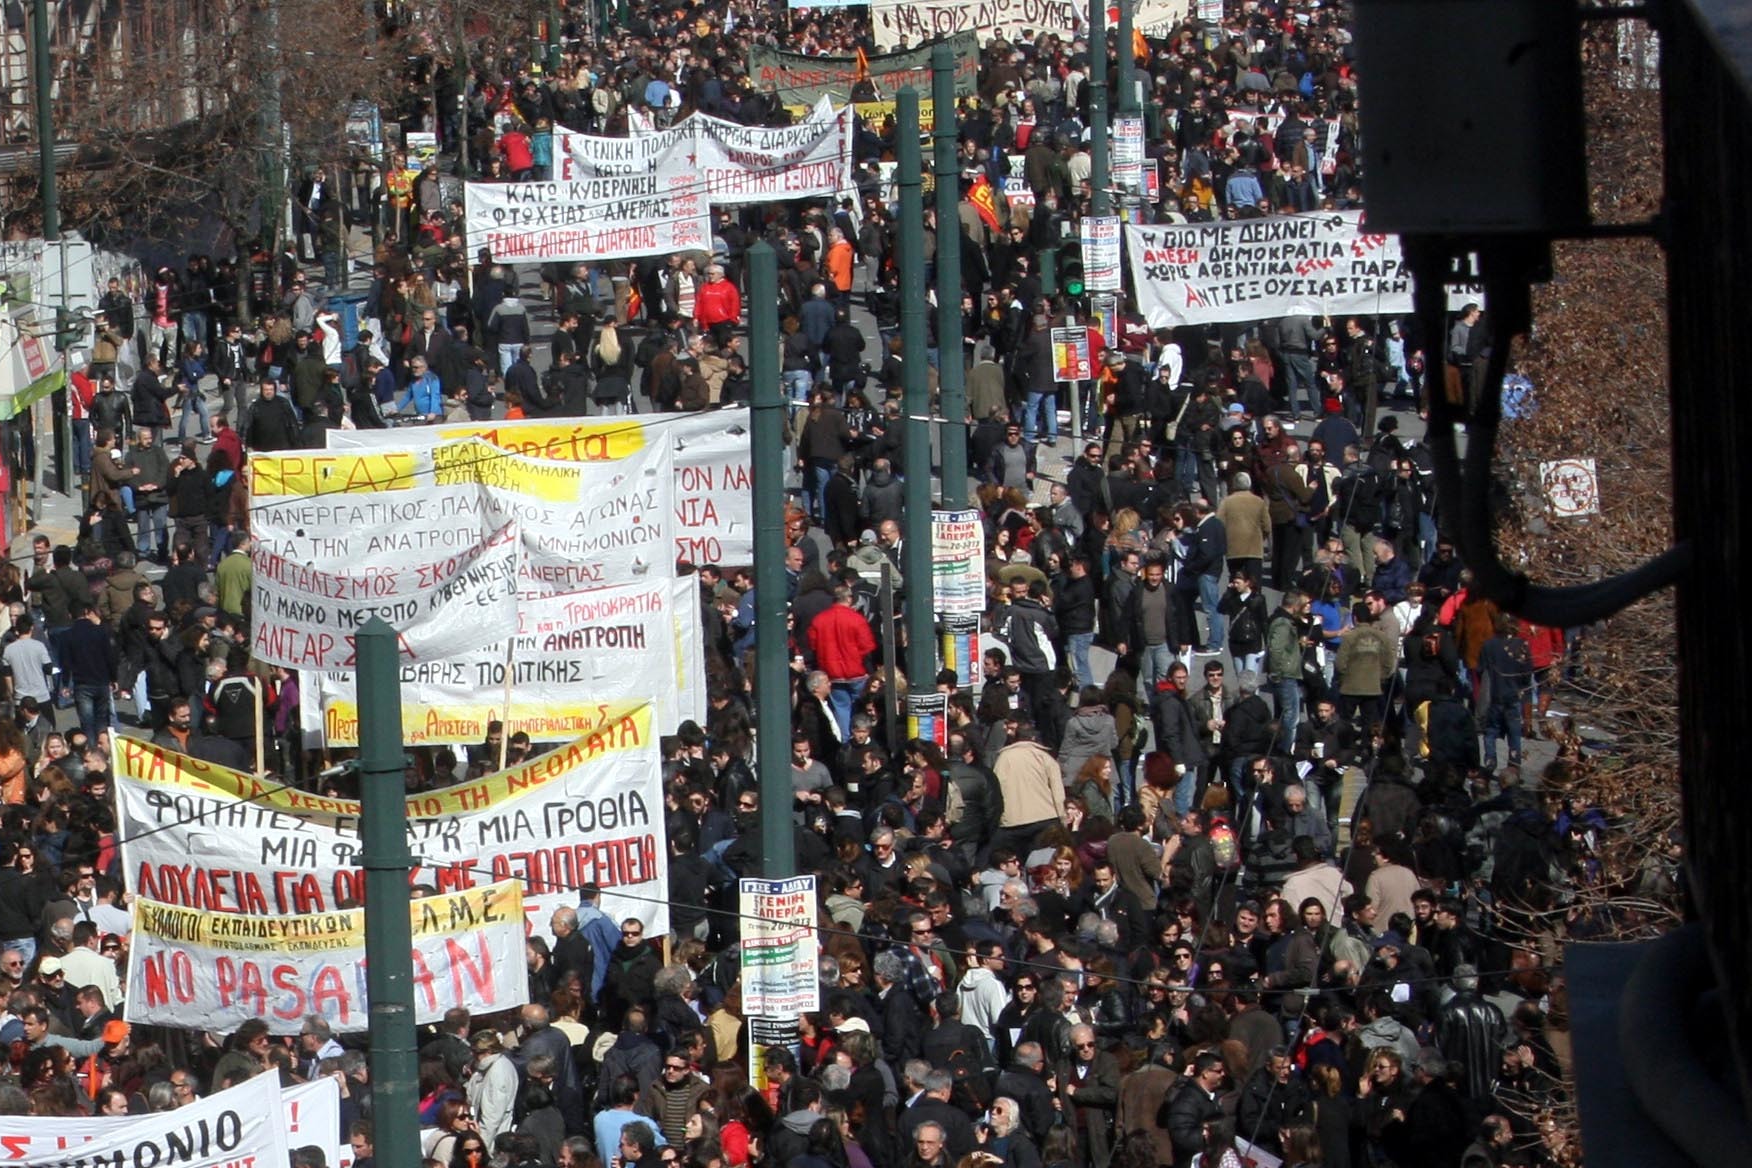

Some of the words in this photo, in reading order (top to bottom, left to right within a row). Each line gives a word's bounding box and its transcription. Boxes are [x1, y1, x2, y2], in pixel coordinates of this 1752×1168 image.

[506, 184, 557, 203] ΚΑΤΩ
[569, 175, 657, 200] ΚΥΒΕΡΝΗΣΗ
[706, 167, 777, 194] ΕΡΓΑΤΙΚΗ
[492, 204, 587, 226] ΦΤΩΧΕΙΑΣ
[487, 231, 534, 257] ΓΕΝΙΚΗ
[1238, 220, 1317, 244] ΔΕΙΧΝΕΙ
[1142, 249, 1199, 264] ΑΜΕΣΗ
[1208, 240, 1345, 263] ΔΗΜΟΚΡΑΤΙΑ
[1144, 264, 1192, 283] ΧΩΡΙΣ
[1197, 260, 1295, 279] ΑΦΕΝΤΙΚΑ
[251, 453, 409, 497] ΕΡΓΑΣ
[255, 499, 428, 526] ΠΑΝΕΡΓΑΤΙΚΟΣ
[569, 487, 659, 531] ΑΓΩΝΑΣ
[310, 537, 349, 558] ΤΗΝ
[367, 527, 483, 552] ΑΝΑΤΡΟΠΗ
[255, 585, 271, 612] ΤΟ
[277, 596, 326, 625] ΜΑΥΡΟ
[564, 591, 663, 626] ΤΡΟΜΟΚΡΑΤΙΑ
[543, 624, 646, 651] ΑΝΑΤΡΟΠΗ
[450, 784, 491, 811] ΤΗ
[506, 714, 640, 793] ΝΕΟΛΑΙΑ
[145, 789, 314, 833] ΦΟΙΤΗΤΕΣ
[478, 808, 536, 846] ΜΙΑ
[544, 789, 649, 839] ΓΡΟΘΙΑ
[261, 835, 317, 869] ΜΙΑ
[211, 914, 353, 938] ΕΚΠΑΙΔΕΥΤΙΚΩΝ
[142, 950, 194, 1009] NO
